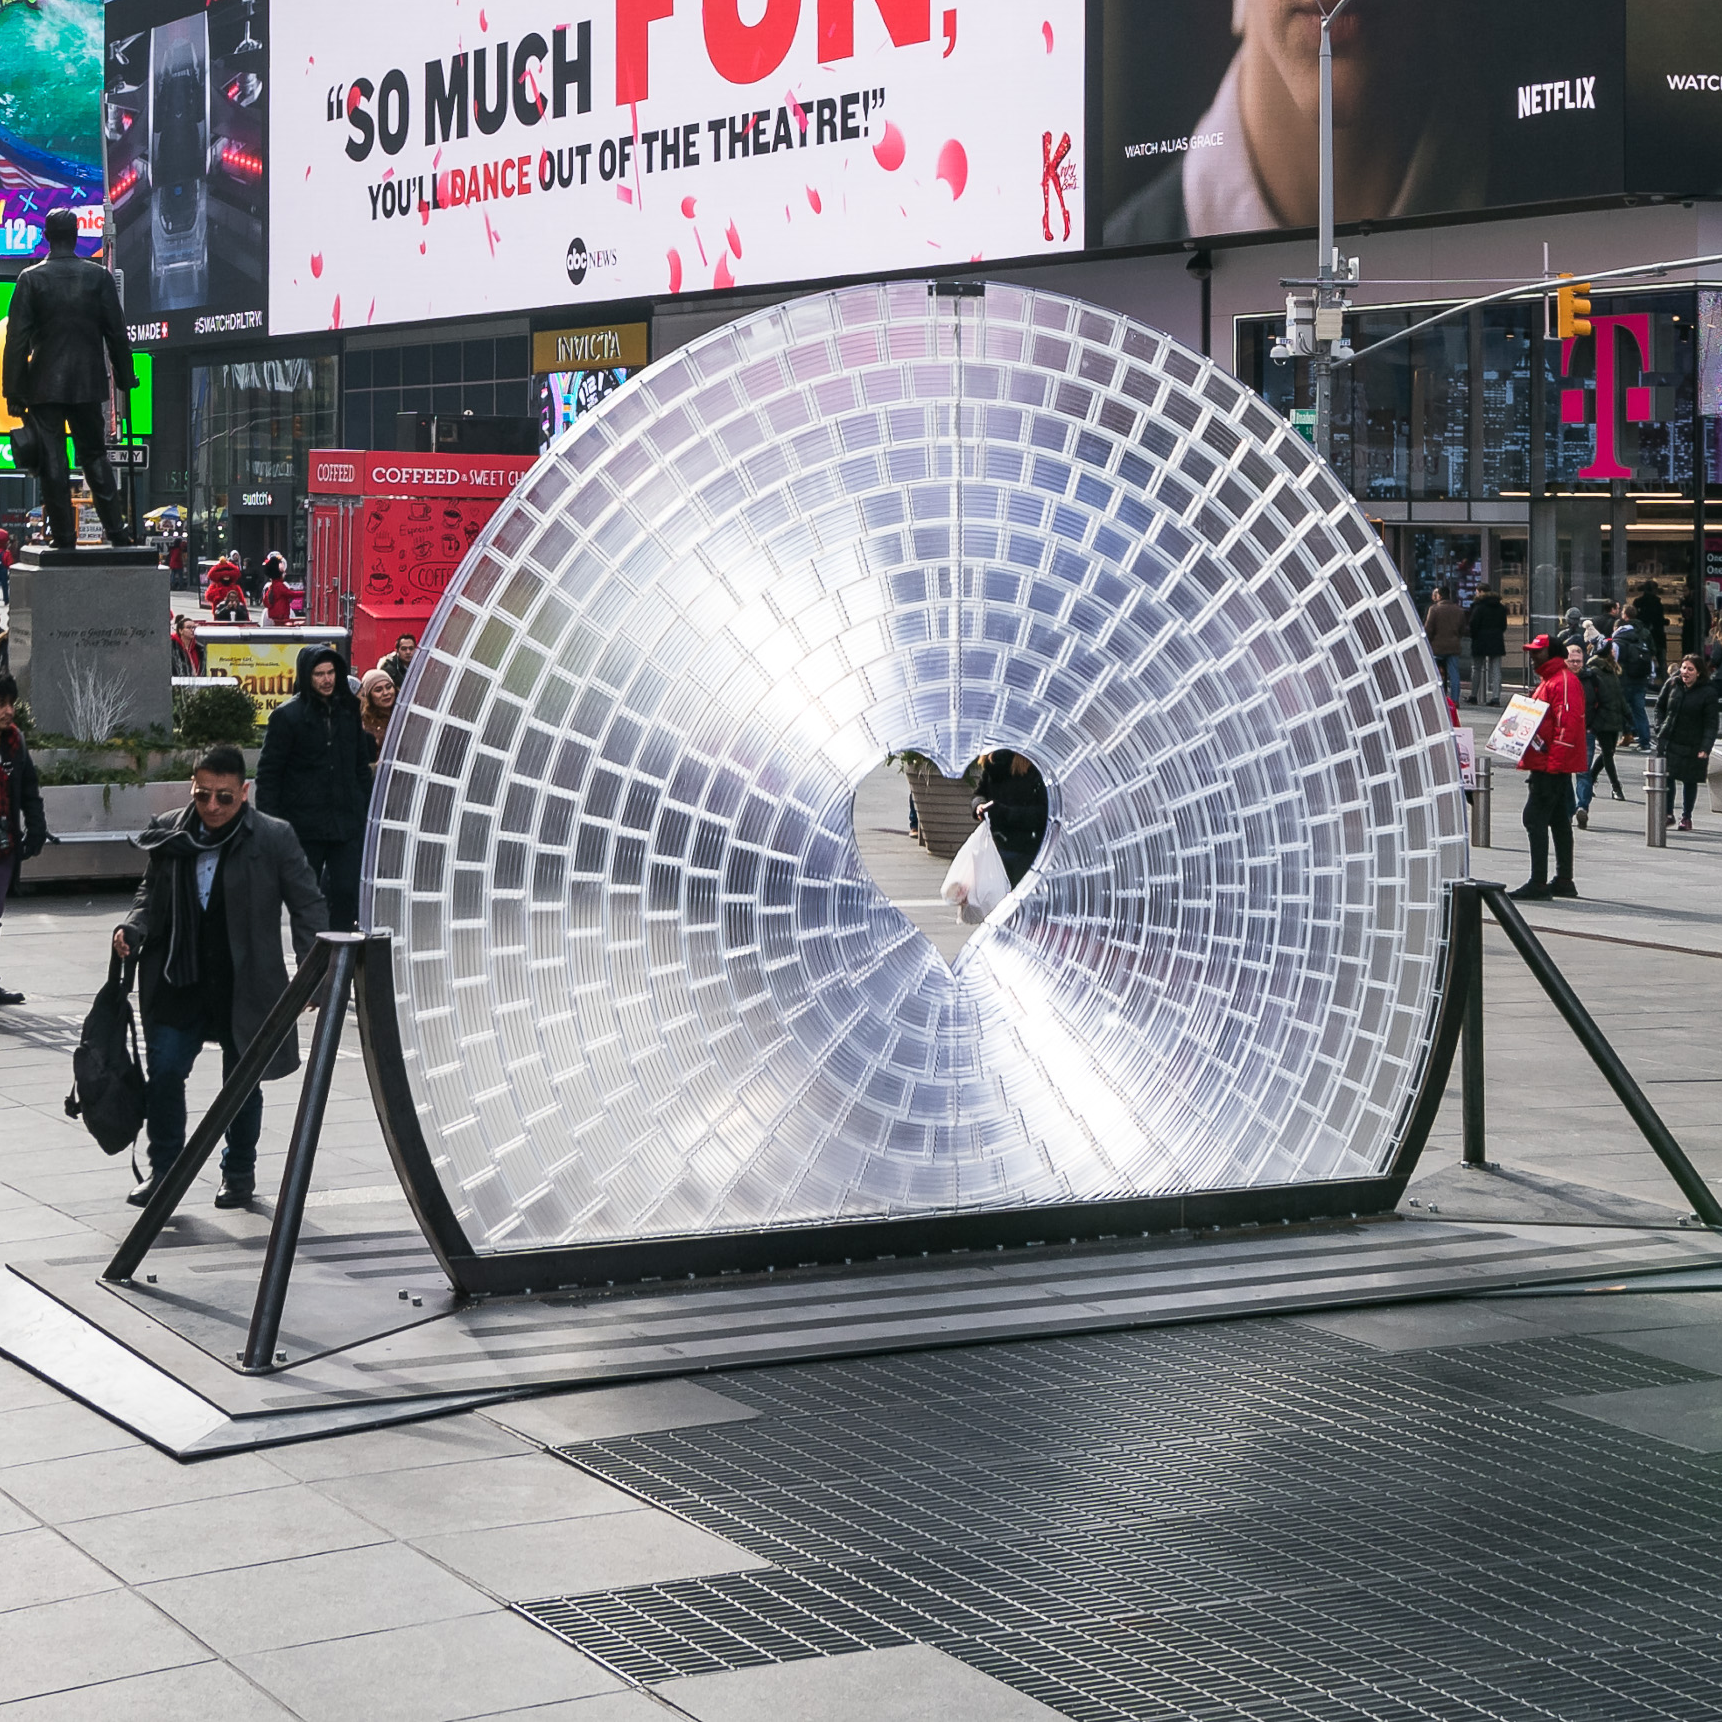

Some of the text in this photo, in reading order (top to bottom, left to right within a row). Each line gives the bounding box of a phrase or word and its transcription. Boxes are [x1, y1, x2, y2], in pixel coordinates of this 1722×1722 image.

[325, 75, 410, 163] “SO
[424, 19, 593, 148] MUCH
[1517, 76, 1596, 120] NETFLIX
[1124, 131, 1224, 159] WATCH ALIAS GRACE
[446, 154, 532, 208] DANCE
[538, 142, 593, 193] OUT
[598, 133, 636, 181] OF
[640, 121, 702, 177] THE
[567, 246, 618, 274] abc NEWS
[137, 322, 162, 342] MADE
[556, 330, 622, 364] INVICTA
[317, 463, 355, 483] COFFEED
[371, 466, 506, 486] COFFEED SWEET
[242, 491, 268, 507] swatch
[1706, 553, 1722, 563] One
[1706, 565, 1722, 575] One
